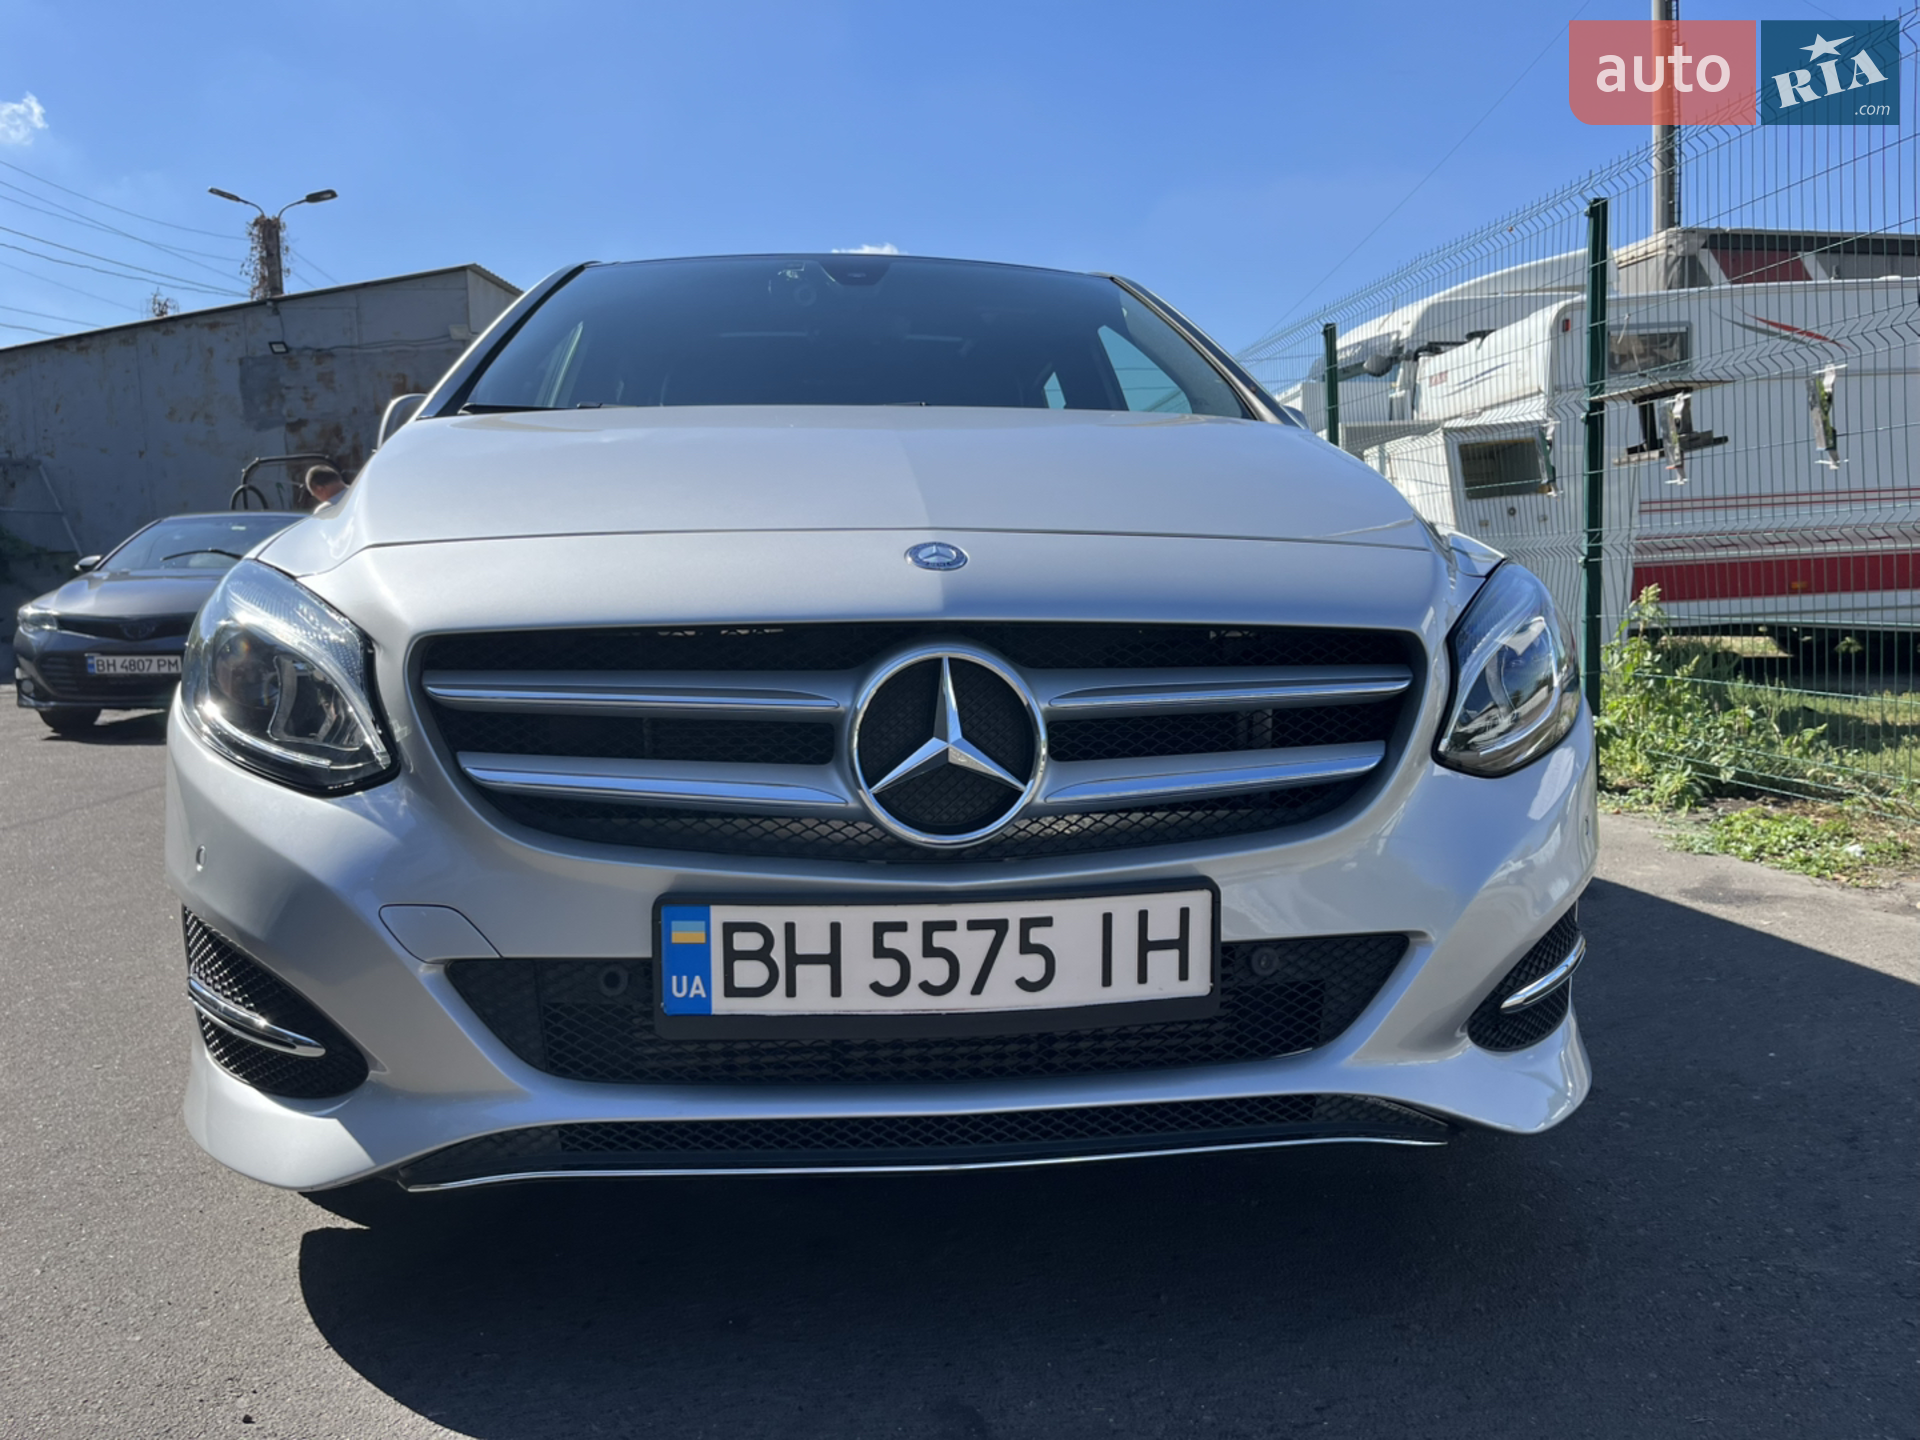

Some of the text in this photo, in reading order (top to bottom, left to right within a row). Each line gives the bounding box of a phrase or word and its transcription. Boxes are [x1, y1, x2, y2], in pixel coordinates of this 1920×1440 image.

[96, 658, 179, 672] BH 4807 PM
[722, 906, 1190, 998] BH 5575 IH
[671, 975, 707, 999] UA
